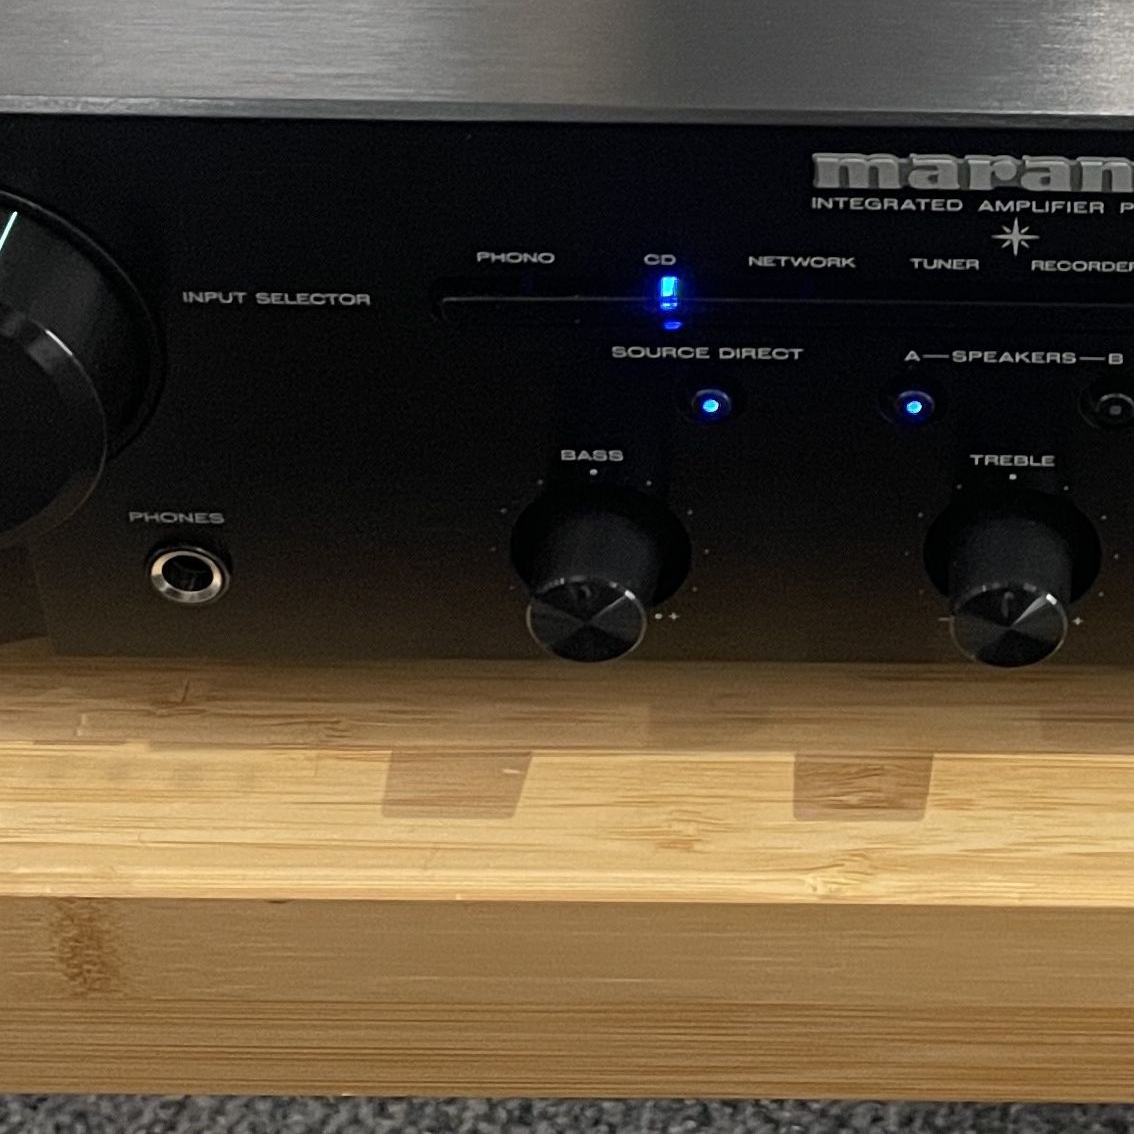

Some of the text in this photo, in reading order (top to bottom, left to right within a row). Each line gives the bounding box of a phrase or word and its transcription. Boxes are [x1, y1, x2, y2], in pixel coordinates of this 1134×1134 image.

[811, 197, 964, 212] INTEGRATED
[977, 199, 1105, 214] AMPLIFIER
[476, 251, 556, 264] PHONO
[643, 253, 677, 266] CD
[748, 255, 856, 269] NETWORK
[910, 257, 980, 271] TUNER
[182, 291, 371, 306] INPUT SELECTOR
[611, 345, 804, 360] SOURCE DIRECT
[560, 449, 624, 462] BASS
[969, 454, 1055, 467] TREBLE
[128, 511, 225, 524] PHONES
